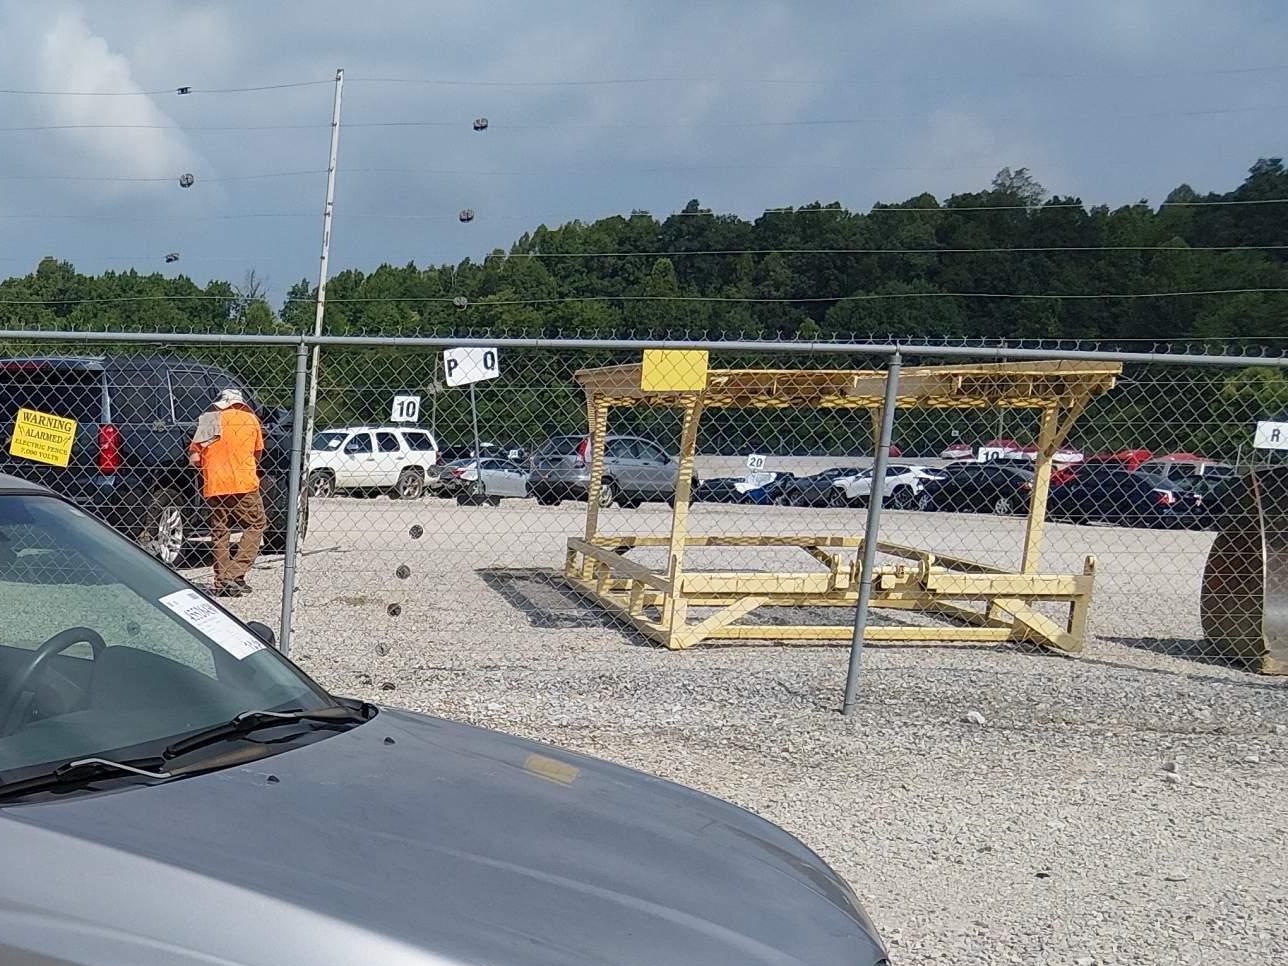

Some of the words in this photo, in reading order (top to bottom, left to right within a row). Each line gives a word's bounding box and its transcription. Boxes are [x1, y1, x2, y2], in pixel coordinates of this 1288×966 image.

[447, 358, 458, 378] P
[397, 401, 416, 418] 10
[23, 411, 72, 432] WARNING
[25, 428, 64, 444] ALARMED
[1270, 428, 1281, 443] R
[14, 438, 46, 450] ELECTRIC
[47, 445, 68, 456] FENCE
[749, 456, 763, 467] 20
